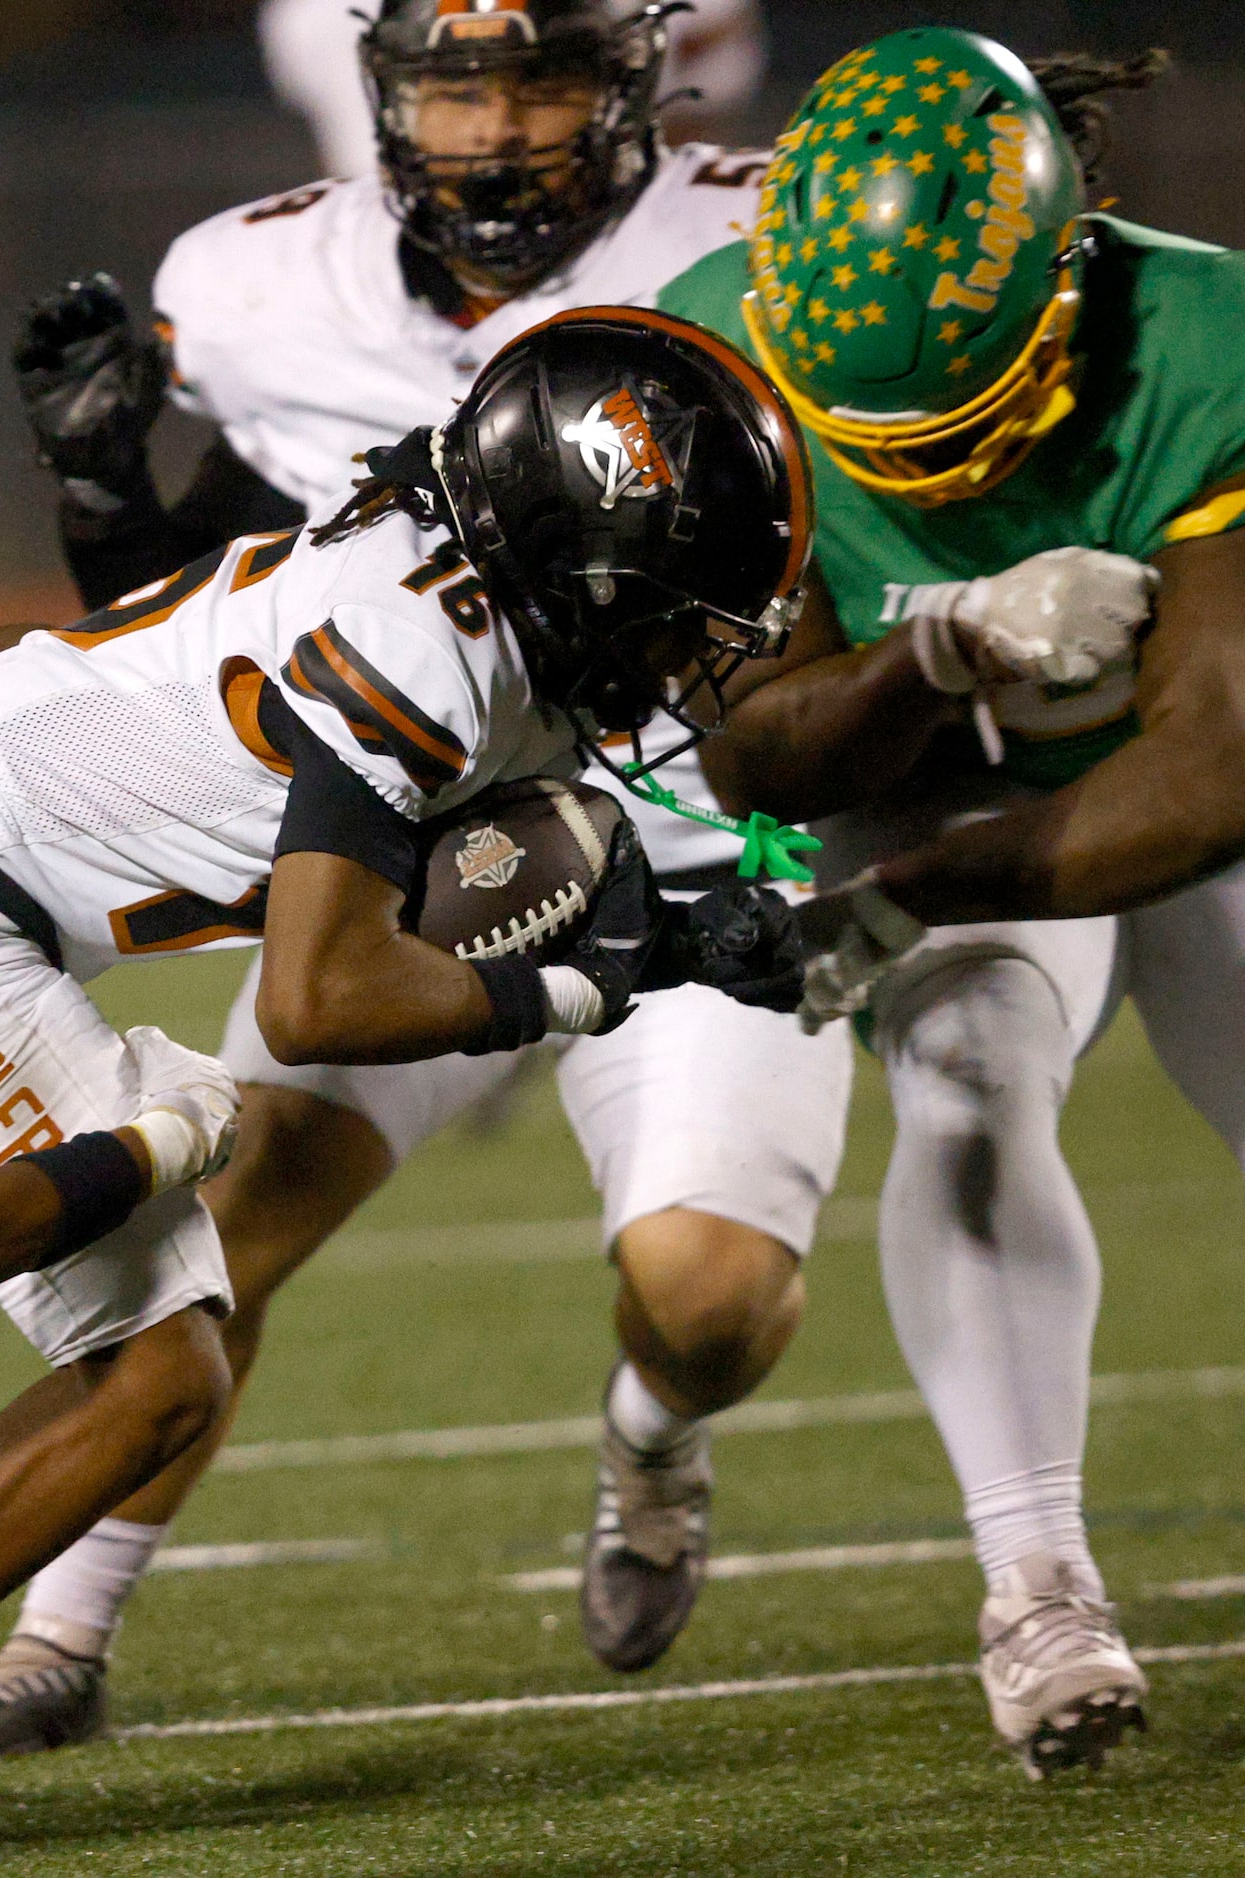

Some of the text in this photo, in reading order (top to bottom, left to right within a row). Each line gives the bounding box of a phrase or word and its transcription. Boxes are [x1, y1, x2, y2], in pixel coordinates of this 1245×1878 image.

[928, 113, 1035, 313] Trojans
[602, 387, 674, 490] WEST
[397, 536, 491, 641] 16
